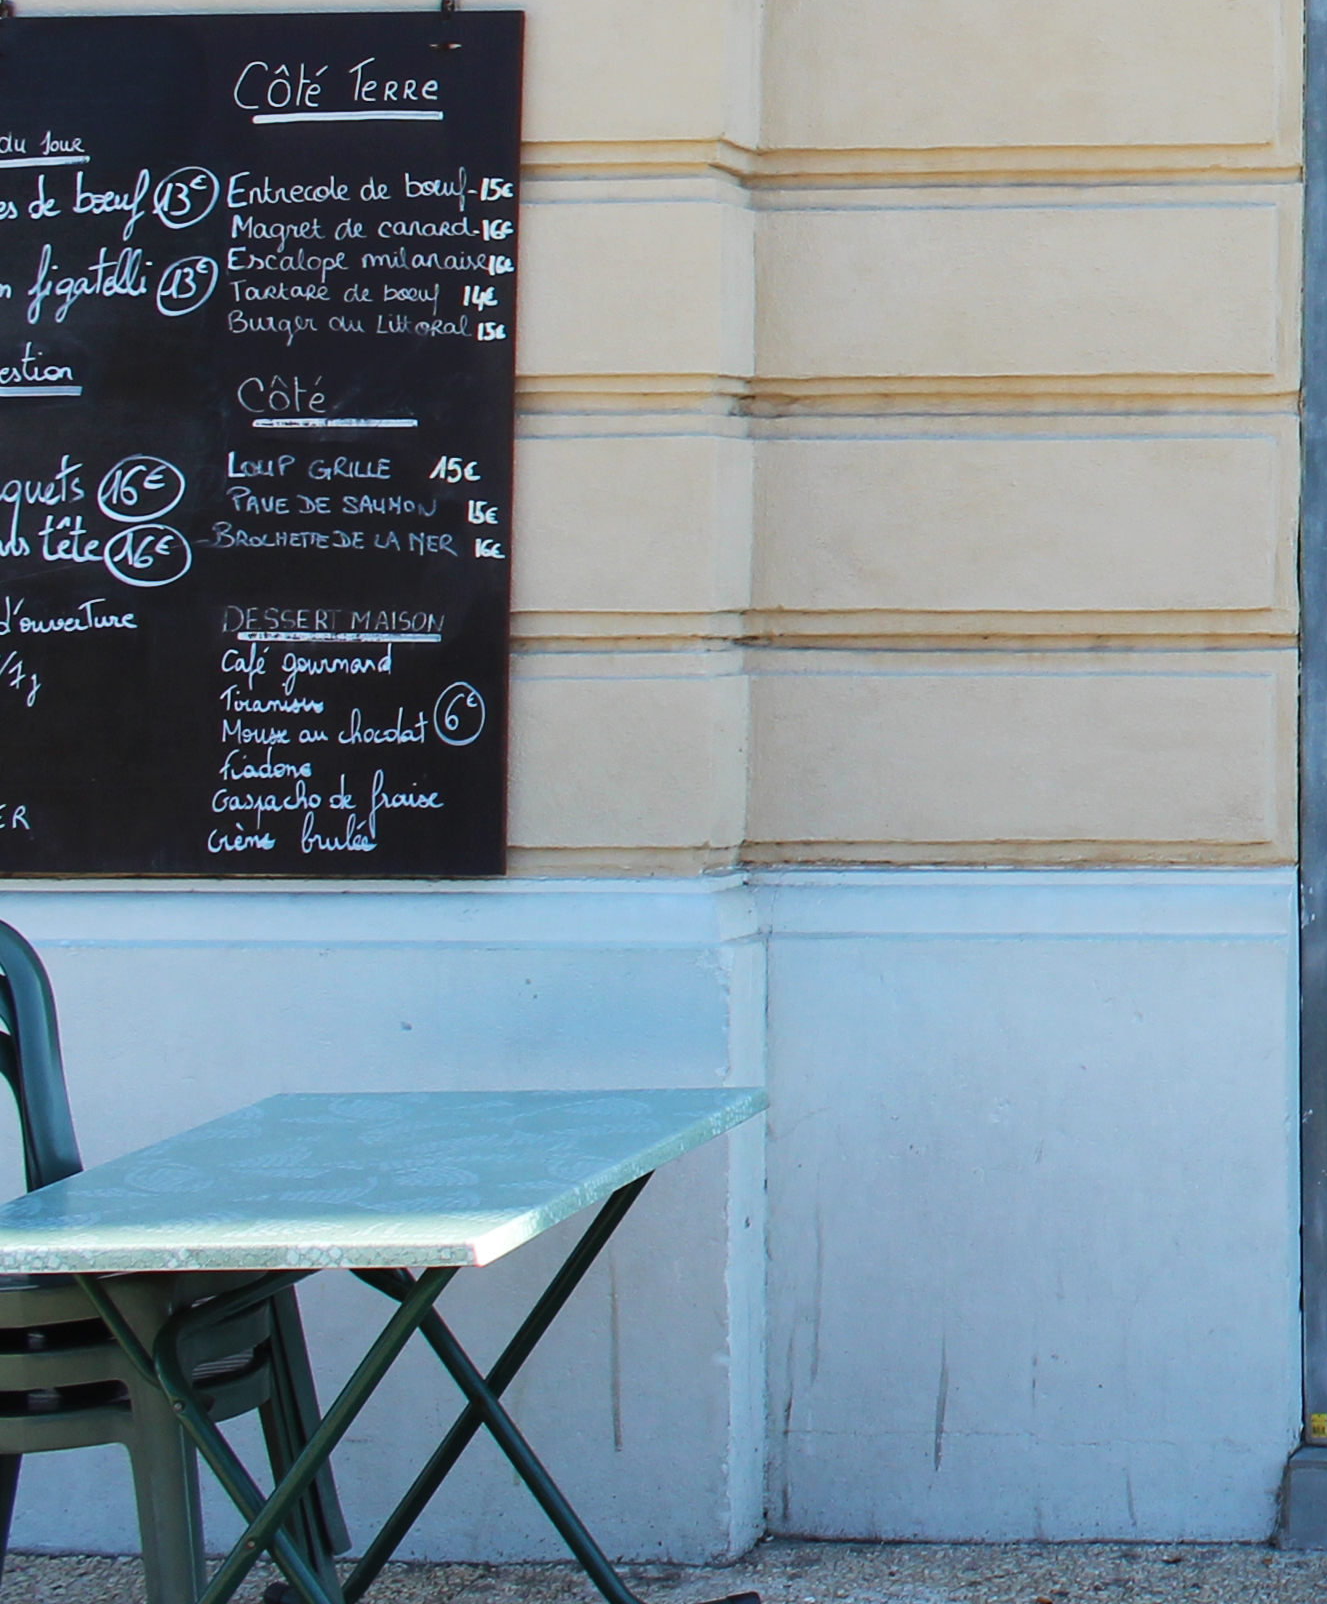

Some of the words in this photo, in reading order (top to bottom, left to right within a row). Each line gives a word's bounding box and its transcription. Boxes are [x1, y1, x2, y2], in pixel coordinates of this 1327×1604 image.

[233, 60, 329, 110] Côté
[28, 173, 62, 220] de
[360, 176, 392, 201] de
[231, 214, 326, 254] Magret
[334, 218, 368, 241] de
[226, 246, 349, 284] Escalope
[361, 247, 489, 271] milanaise
[343, 283, 374, 303] de
[227, 309, 318, 347] Burger
[236, 374, 327, 414] Côté
[308, 456, 392, 480] GRILLE
[428, 455, 482, 483] 15€
[296, 494, 332, 514] DE
[342, 495, 437, 517] SAUMON
[38, 514, 104, 563] tête
[331, 529, 365, 550] DE
[374, 530, 401, 552] LA
[407, 531, 459, 557] MER
[222, 605, 342, 633] DESSERT
[350, 609, 445, 633] MAISON
[221, 643, 271, 691] Café
[281, 643, 393, 696] gourmand
[298, 727, 329, 744] au
[338, 707, 428, 745] chocolat
[329, 773, 357, 810] de
[368, 768, 445, 840] fraise
